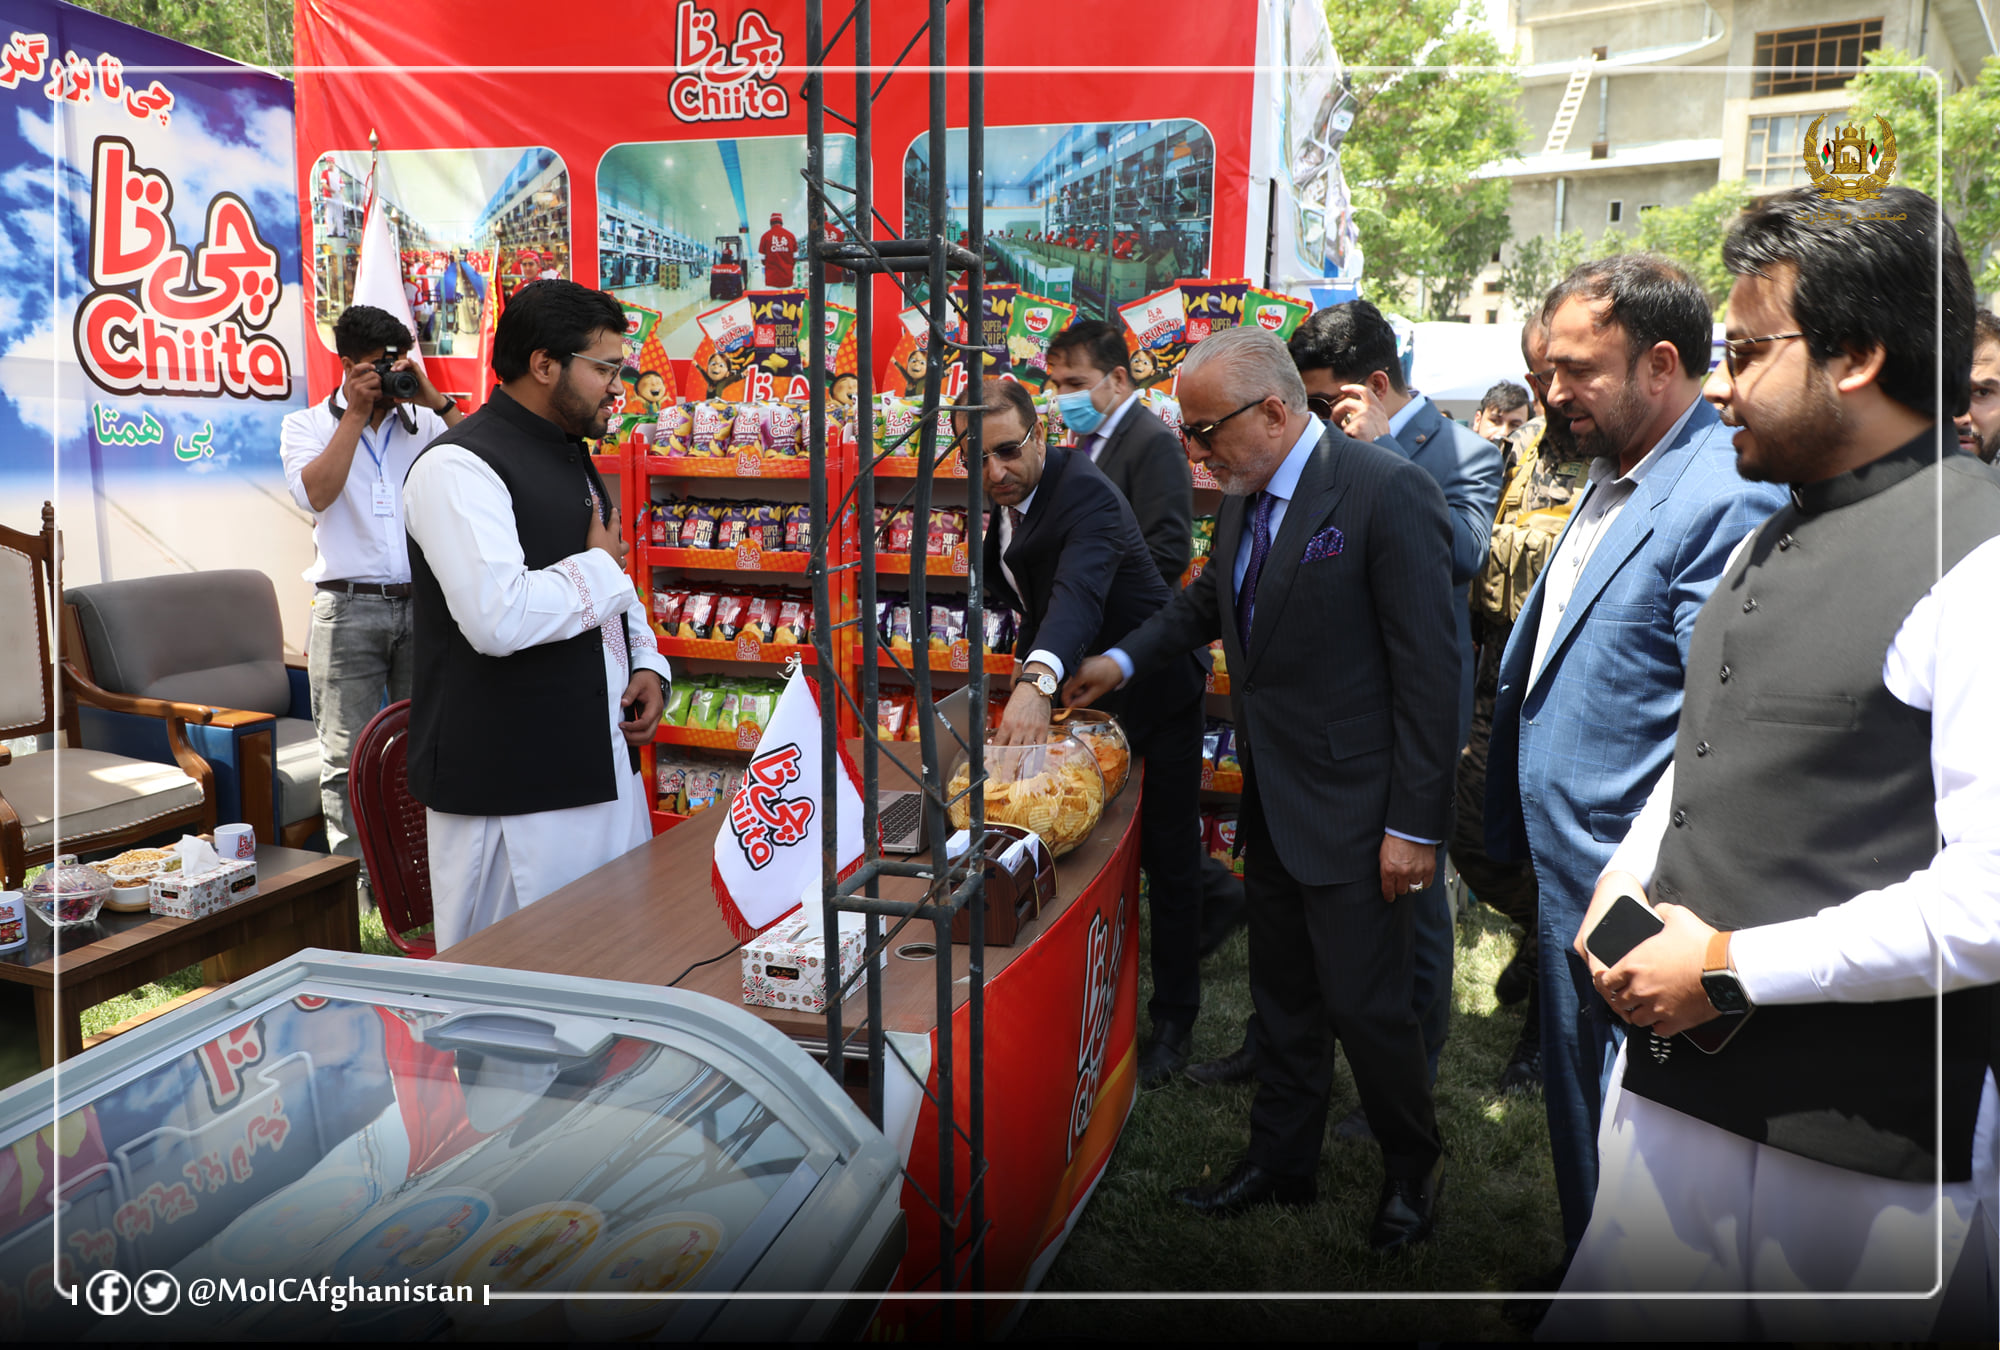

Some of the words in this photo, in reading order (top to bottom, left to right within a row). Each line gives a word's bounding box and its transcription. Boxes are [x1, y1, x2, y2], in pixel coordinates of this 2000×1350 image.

[673, 77, 785, 117] Chiita
[86, 298, 284, 388] Chiita
[775, 335, 797, 347] CHIPS
[1138, 319, 1182, 348] CRUNCHY
[92, 402, 164, 446] همتا
[175, 419, 215, 461] بی
